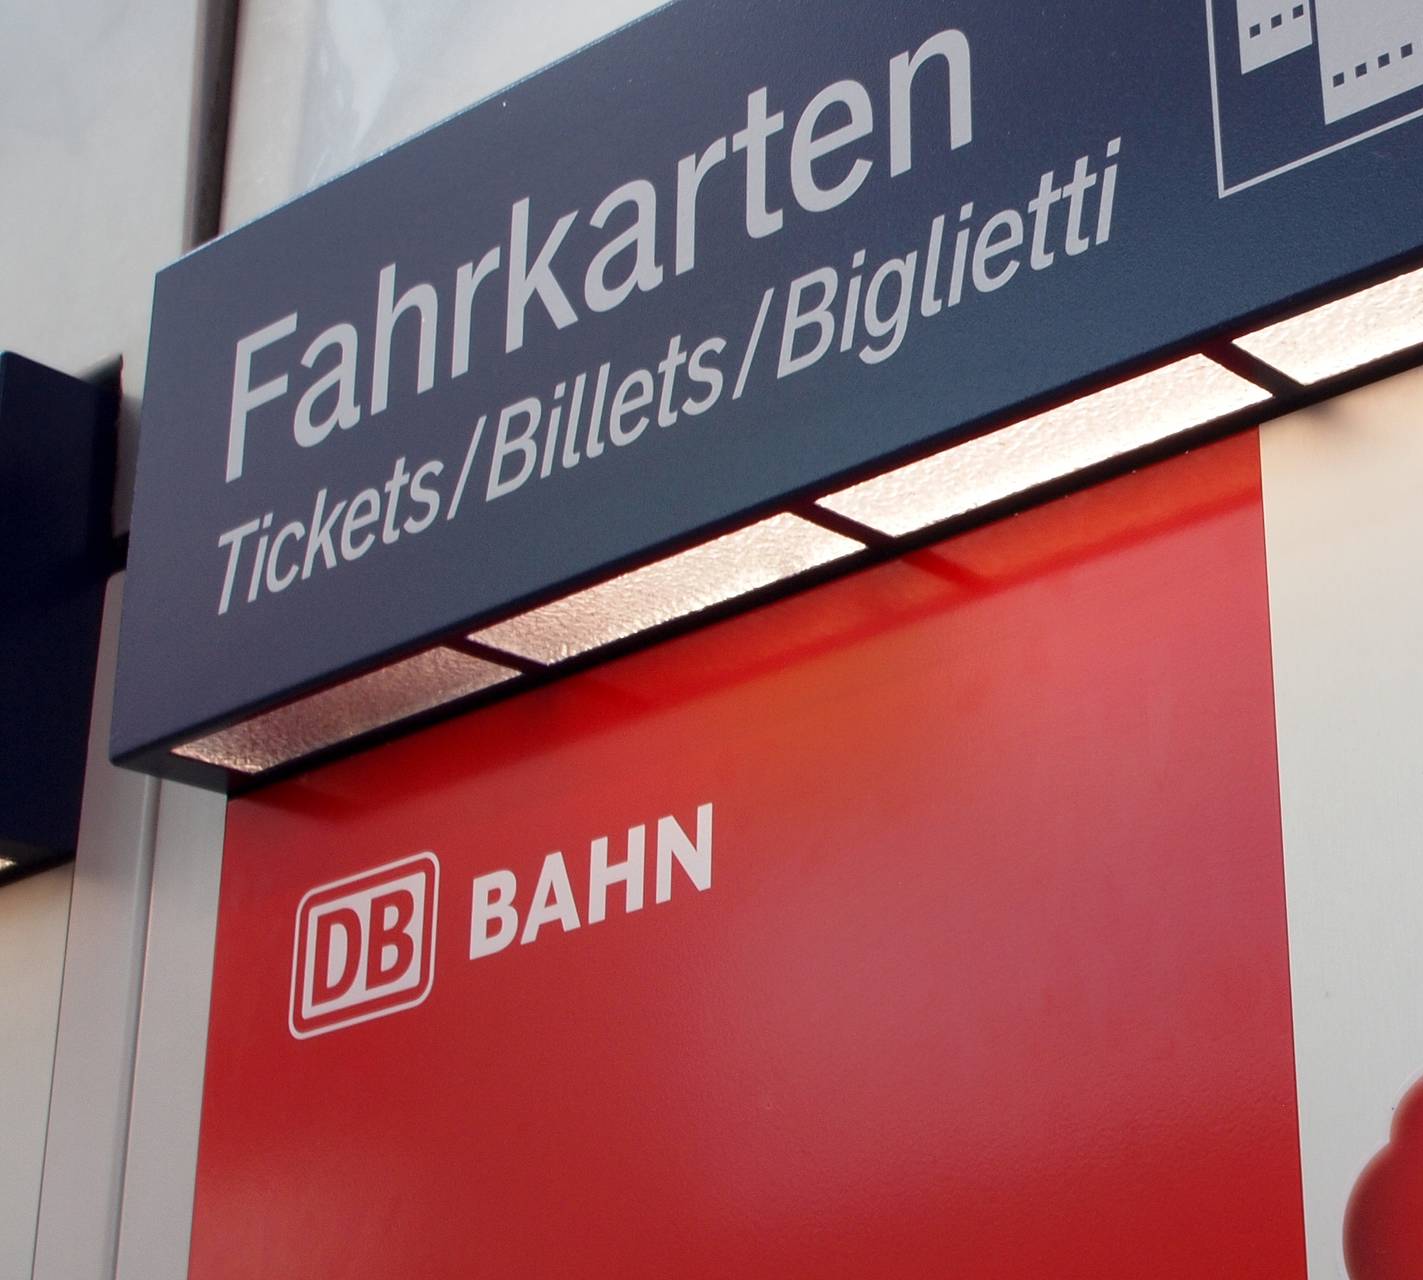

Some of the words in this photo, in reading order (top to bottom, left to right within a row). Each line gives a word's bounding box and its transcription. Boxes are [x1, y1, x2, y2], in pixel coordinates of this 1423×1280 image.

[224, 28, 974, 483] Fahrkarten
[311, 889, 415, 1007] DB
[469, 802, 713, 960] BAHN
